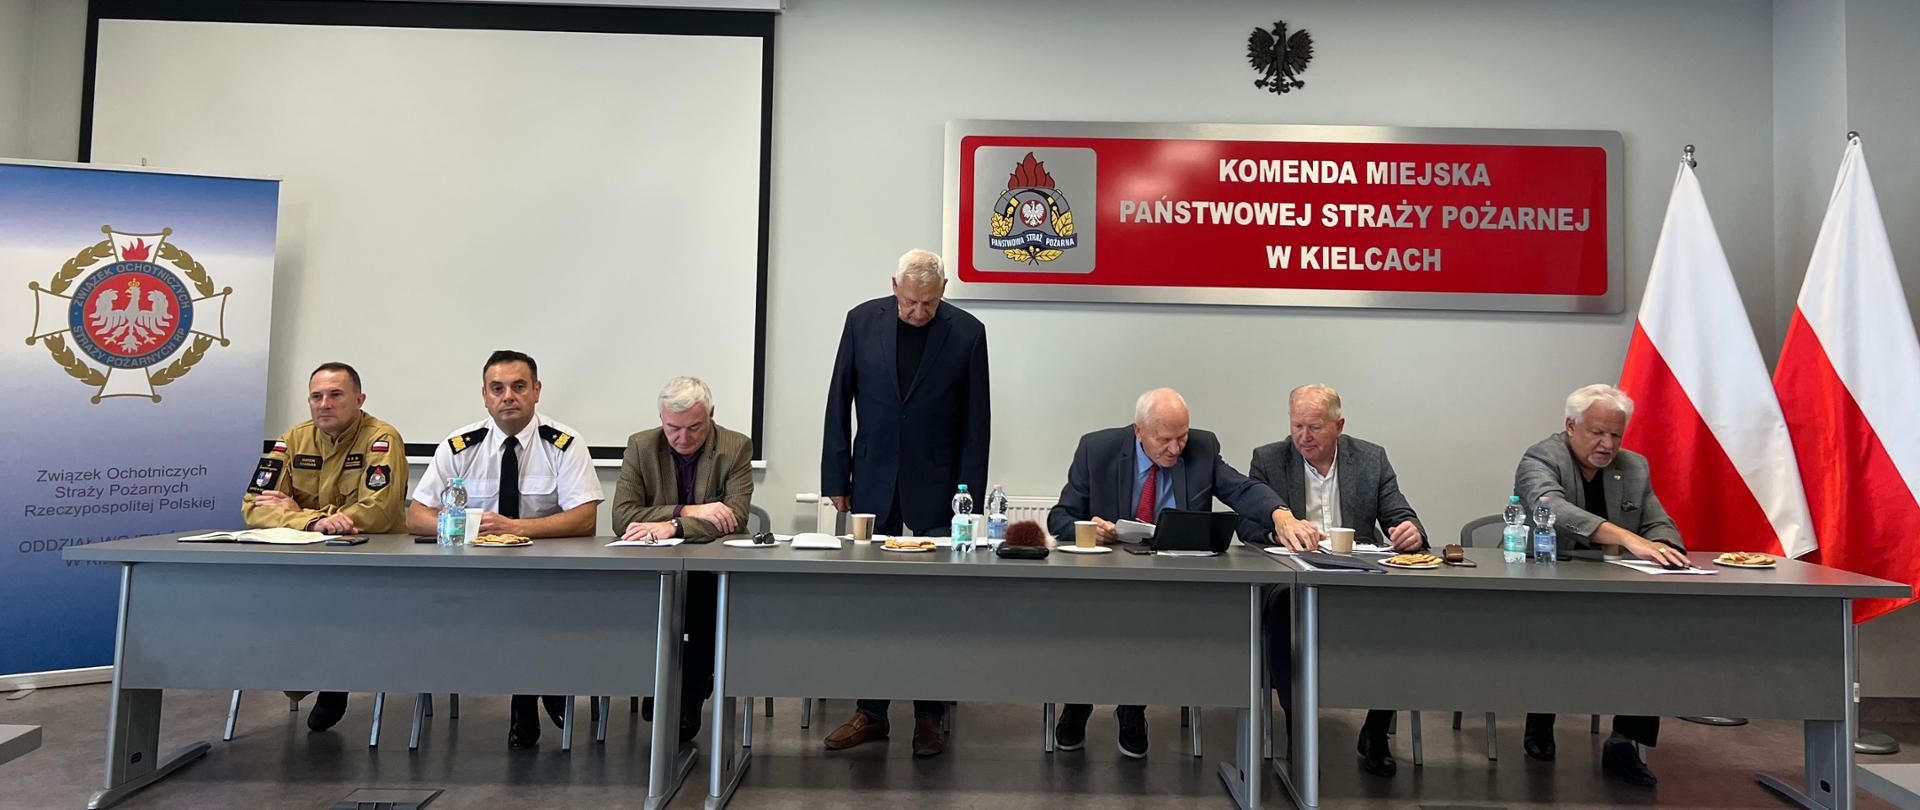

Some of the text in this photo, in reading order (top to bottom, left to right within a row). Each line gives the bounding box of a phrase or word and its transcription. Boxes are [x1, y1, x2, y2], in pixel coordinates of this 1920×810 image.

[1218, 158, 1492, 187] KOMENDA MIEJSKA
[1118, 193, 1591, 232] PAŃSTWOWEJ STRAŻY POŻARNEJ
[991, 233, 1075, 247] PAŃSTWOWA STRAŻ POŻARNA
[1265, 245, 1442, 272] W KIELCACH
[73, 263, 191, 309] ZWIĄZEK OCHOTNICZYCH
[106, 342, 176, 367] POŻARNYCH
[176, 328, 186, 343] RP
[37, 464, 208, 484] Związek Ochotniczych
[54, 482, 189, 499] Straży Pożarnych
[24, 496, 215, 518] Rzeczypospolitej Polskiej
